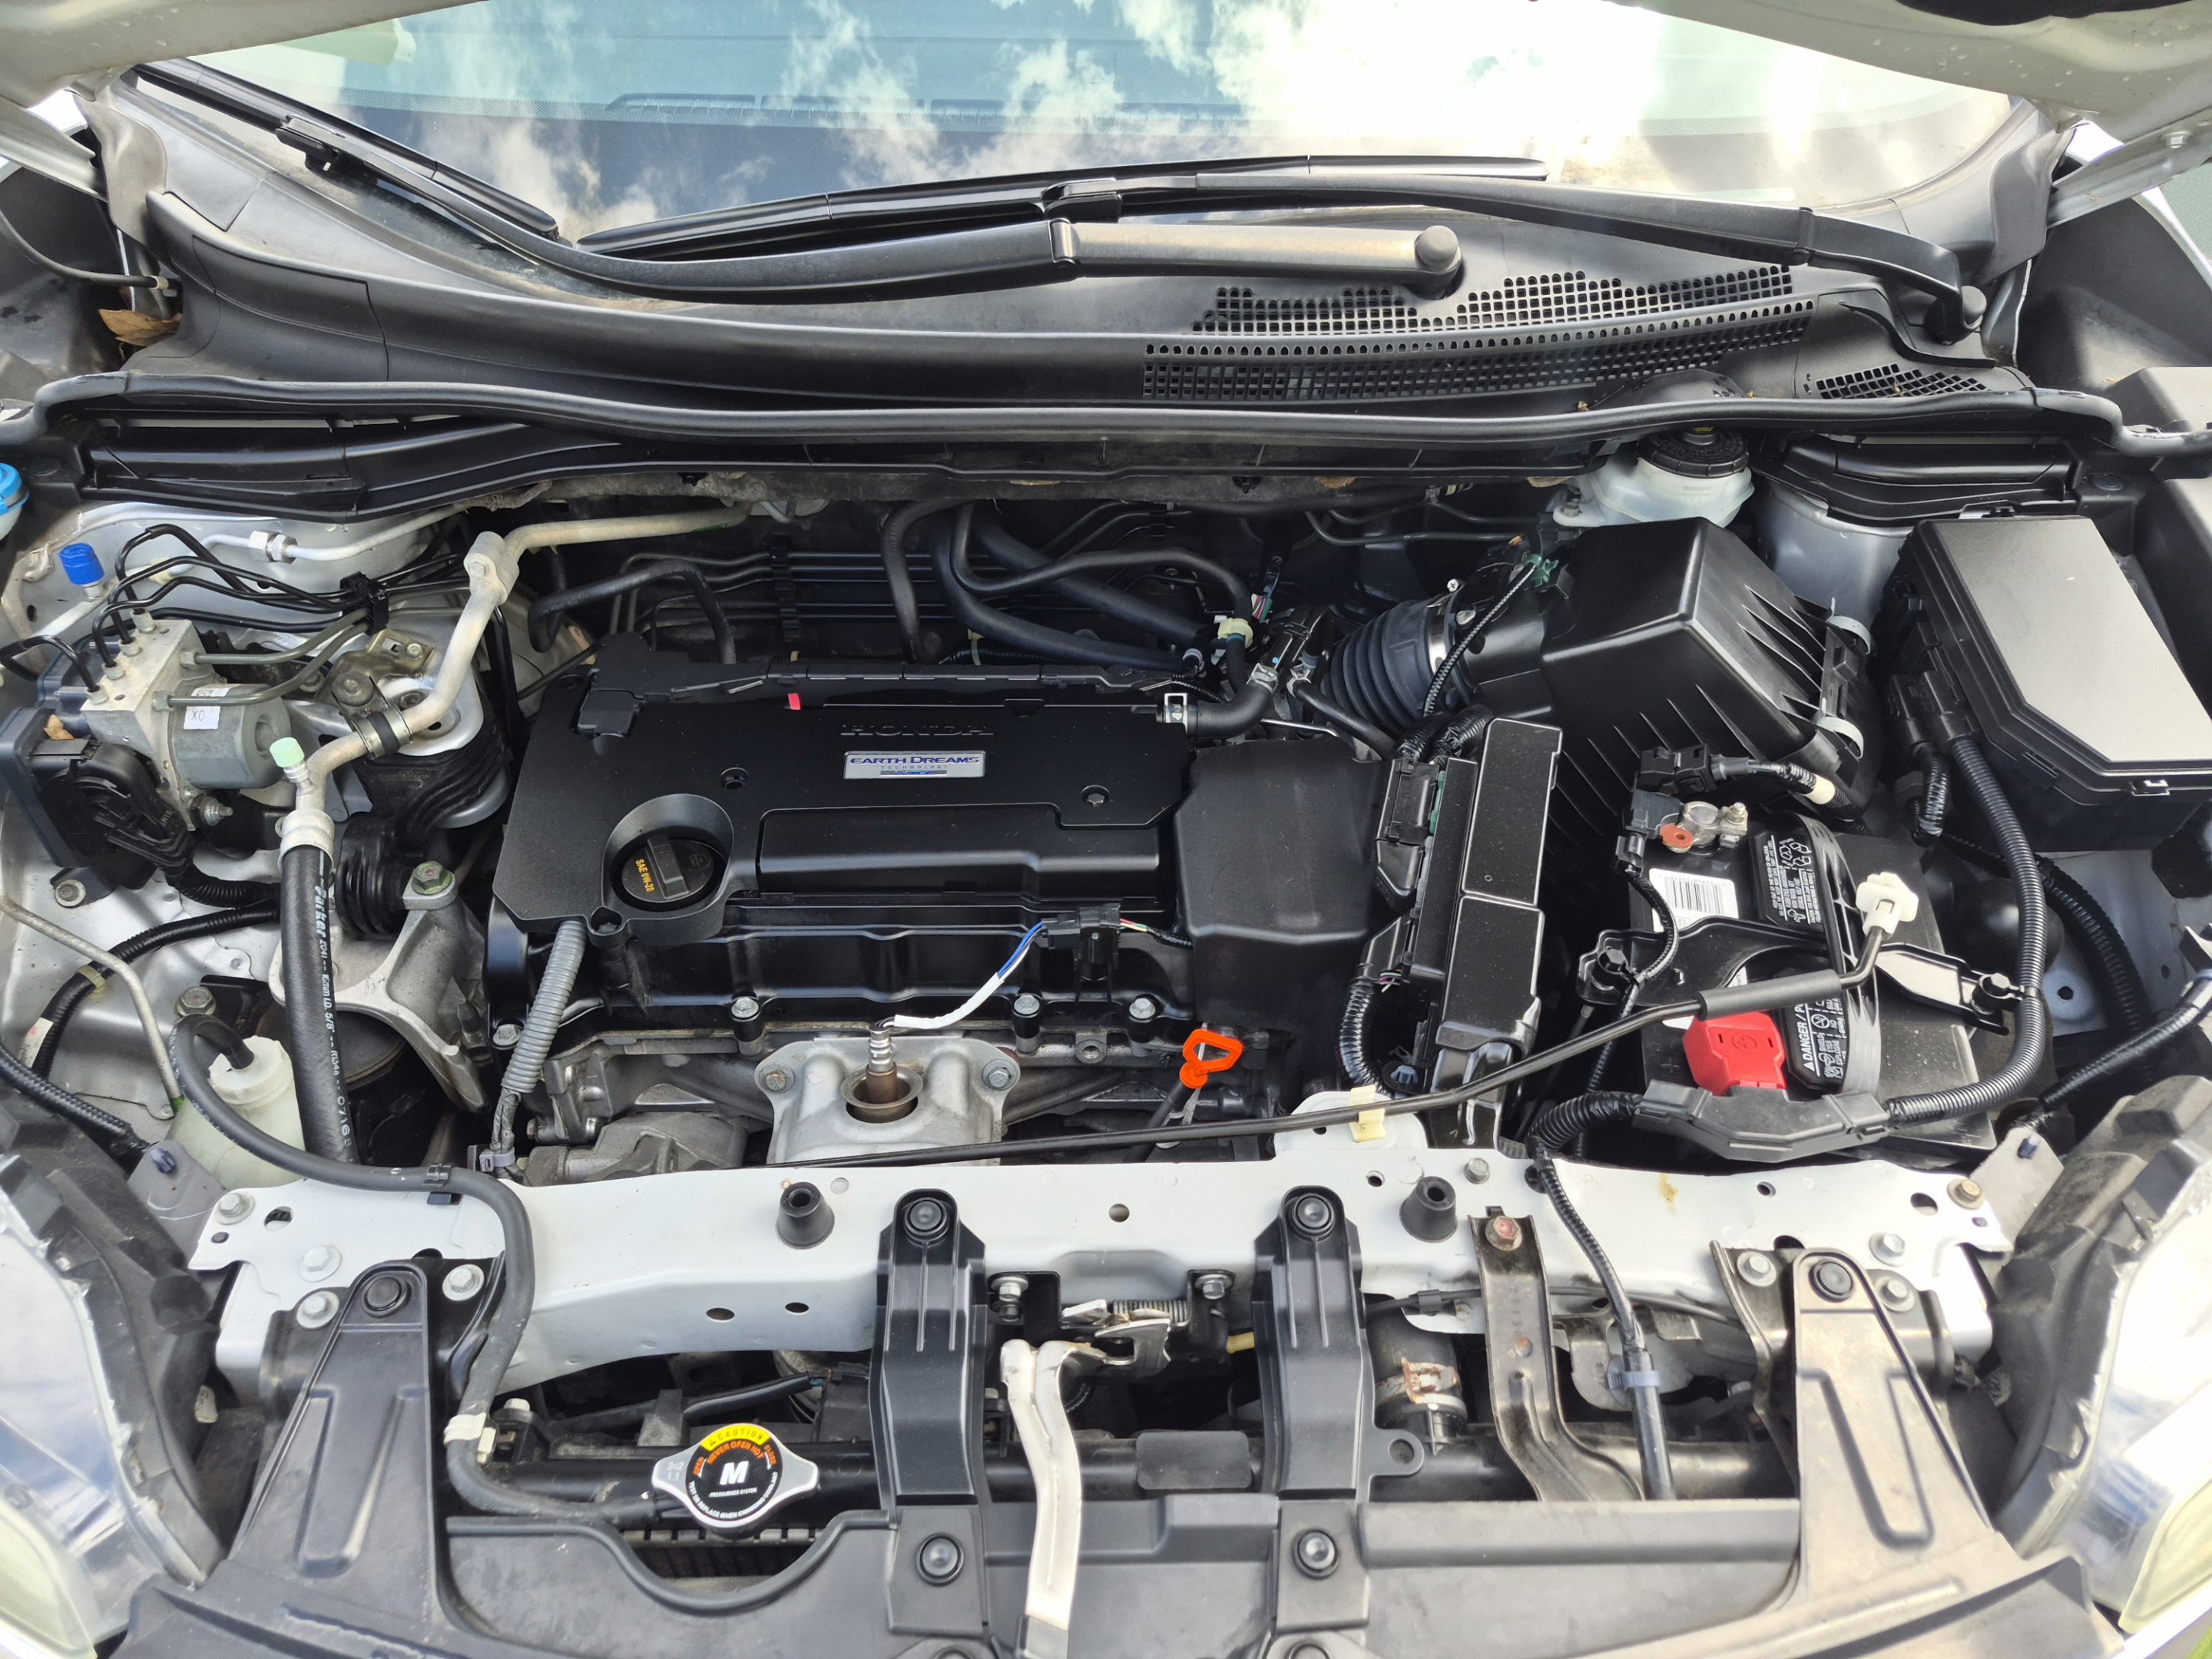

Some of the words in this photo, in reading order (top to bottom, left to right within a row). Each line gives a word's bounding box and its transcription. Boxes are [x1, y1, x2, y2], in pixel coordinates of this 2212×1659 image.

[840, 724, 995, 736] HONDA
[635, 858, 647, 873] SAE
[641, 873, 655, 892] 0W-20
[314, 885, 327, 938] Parker
[321, 973, 331, 996] 16mm
[1830, 1019, 1836, 1028] NO
[1797, 1022, 1812, 1061] DANGER
[1816, 1035, 1826, 1051] SHIELD
[717, 1428, 763, 1441] CAUTION
[706, 1444, 730, 1464] NEVER
[730, 1440, 751, 1449] OPEN
[750, 1445, 764, 1459] HOT
[719, 1460, 750, 1485] M
[692, 1494, 701, 1504] OR
[697, 1502, 720, 1518] REPLACE
